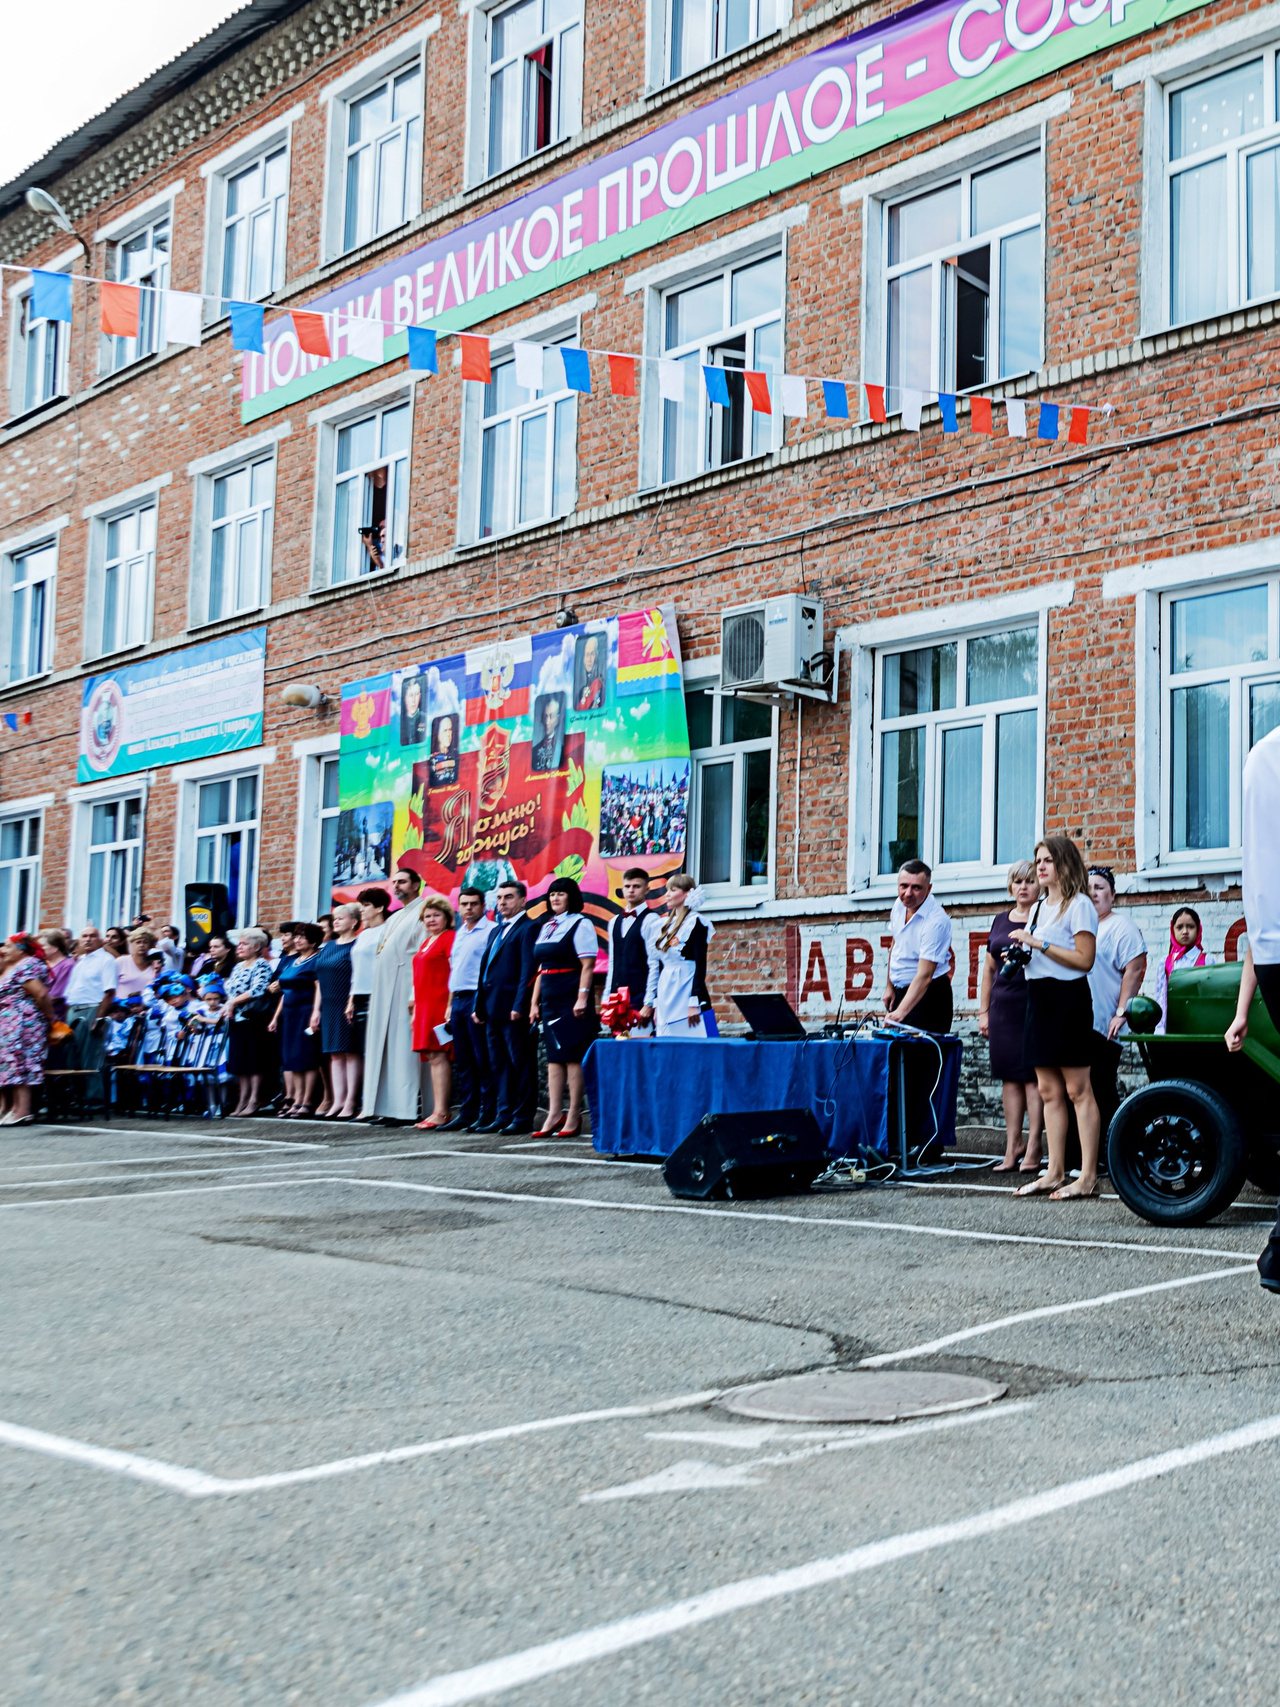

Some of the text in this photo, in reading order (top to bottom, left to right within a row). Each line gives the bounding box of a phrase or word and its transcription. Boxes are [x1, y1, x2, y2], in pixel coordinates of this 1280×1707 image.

[393, 190, 583, 336] ВЕЛИКОЕ
[598, 42, 885, 241] ПРОШЛОЕ
[433, 788, 472, 866] Я
